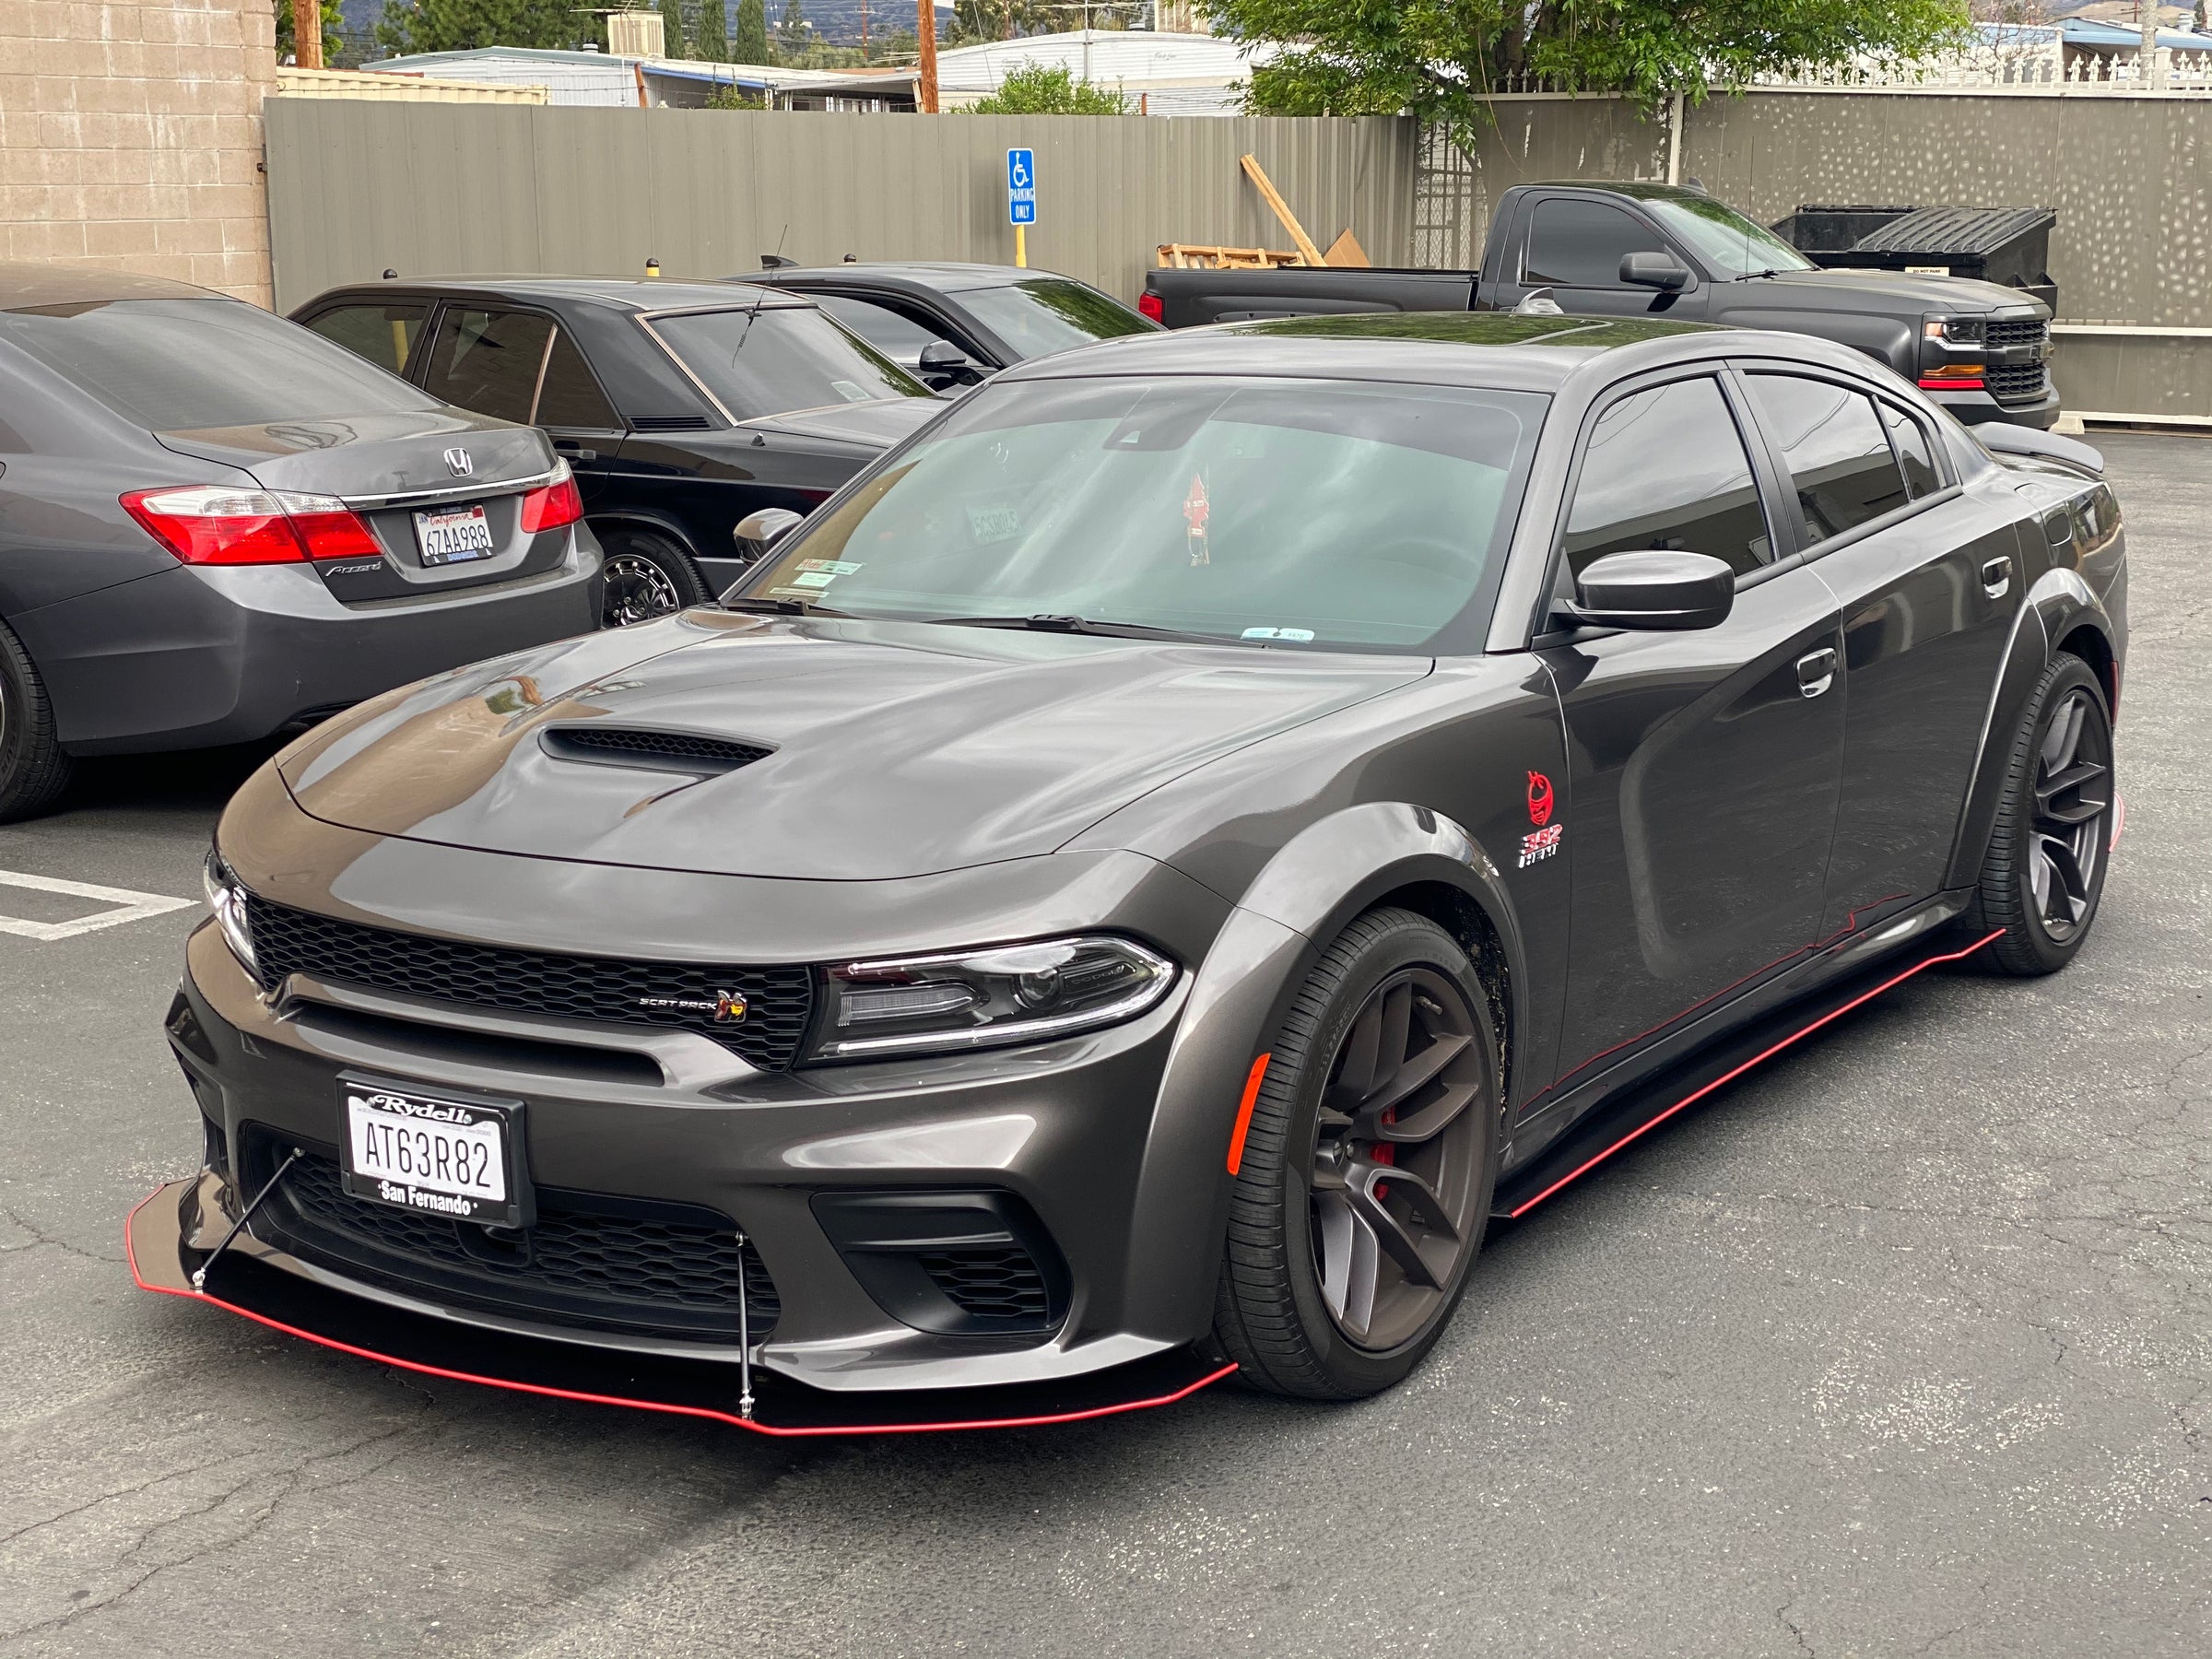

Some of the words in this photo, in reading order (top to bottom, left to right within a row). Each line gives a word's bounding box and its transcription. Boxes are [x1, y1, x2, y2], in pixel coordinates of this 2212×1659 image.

[1010, 188, 1034, 202] PARKING
[1015, 205, 1030, 218] ONLY
[429, 513, 469, 526] California
[325, 561, 382, 577] Accord
[1521, 824, 1562, 854] 392
[639, 997, 678, 1007] SCAT
[677, 1000, 718, 1010] PACK
[373, 1095, 465, 1124] Rydell
[366, 1122, 491, 1188] AT63R82
[381, 1180, 406, 1203] San
[407, 1185, 471, 1216] Fernando
